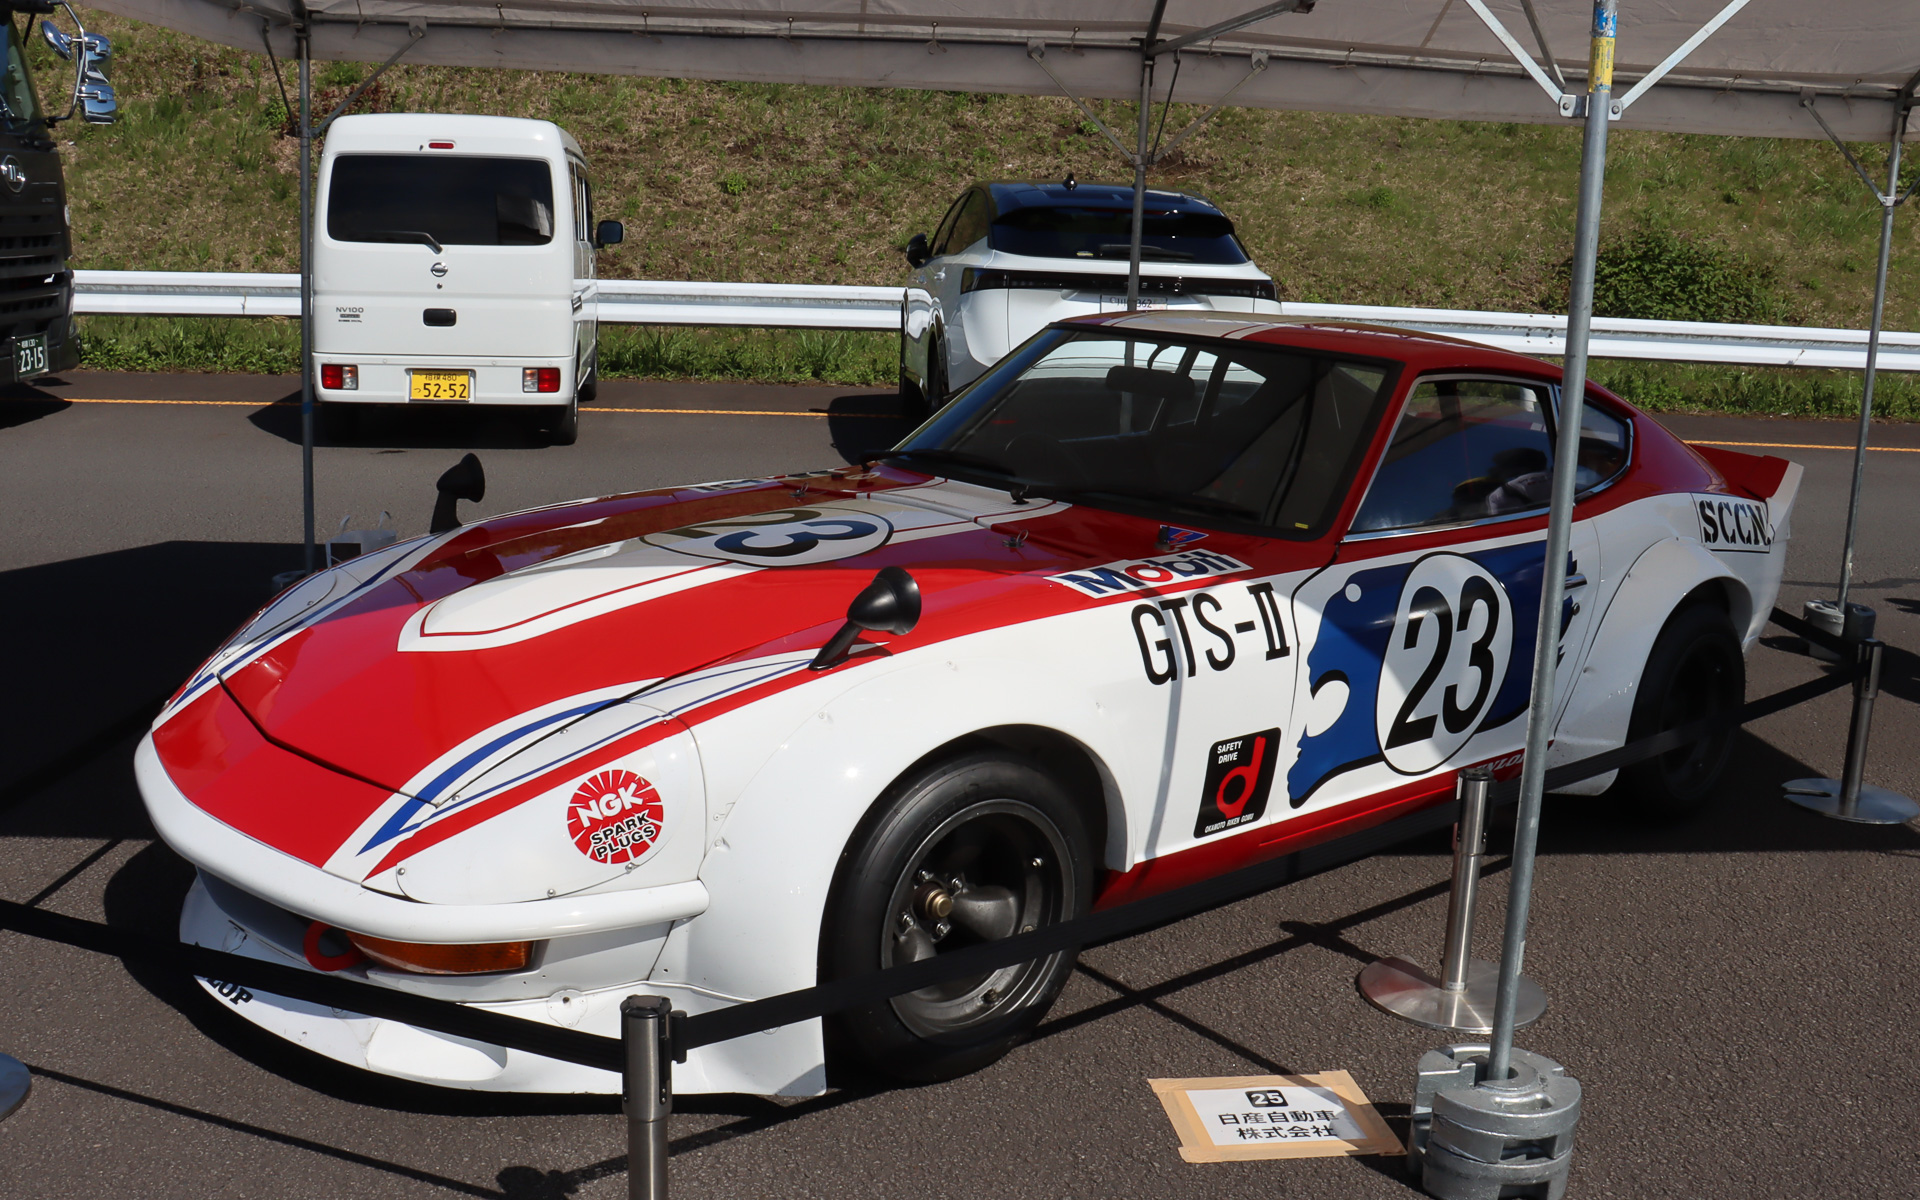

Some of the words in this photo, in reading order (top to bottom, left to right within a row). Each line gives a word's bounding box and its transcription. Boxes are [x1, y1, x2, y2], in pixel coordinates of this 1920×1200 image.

[20, 346, 44, 371] 23-15
[442, 373, 457, 381] 480
[424, 383, 467, 398] 52-52
[1056, 551, 1241, 594] Mobil
[1384, 575, 1500, 751] 23
[1217, 741, 1242, 754] SAFETY
[1218, 752, 1238, 764] DRIVE
[576, 782, 643, 828] NGK
[591, 811, 650, 845] SPARK
[1205, 821, 1226, 833] OKAMOTO
[1227, 817, 1240, 828] RIKEN
[595, 825, 655, 859] PLUGS
[1250, 1092, 1285, 1105] 25
[1218, 1110, 1339, 1126] 日産自動車
[1236, 1125, 1338, 1140] 株式会社
